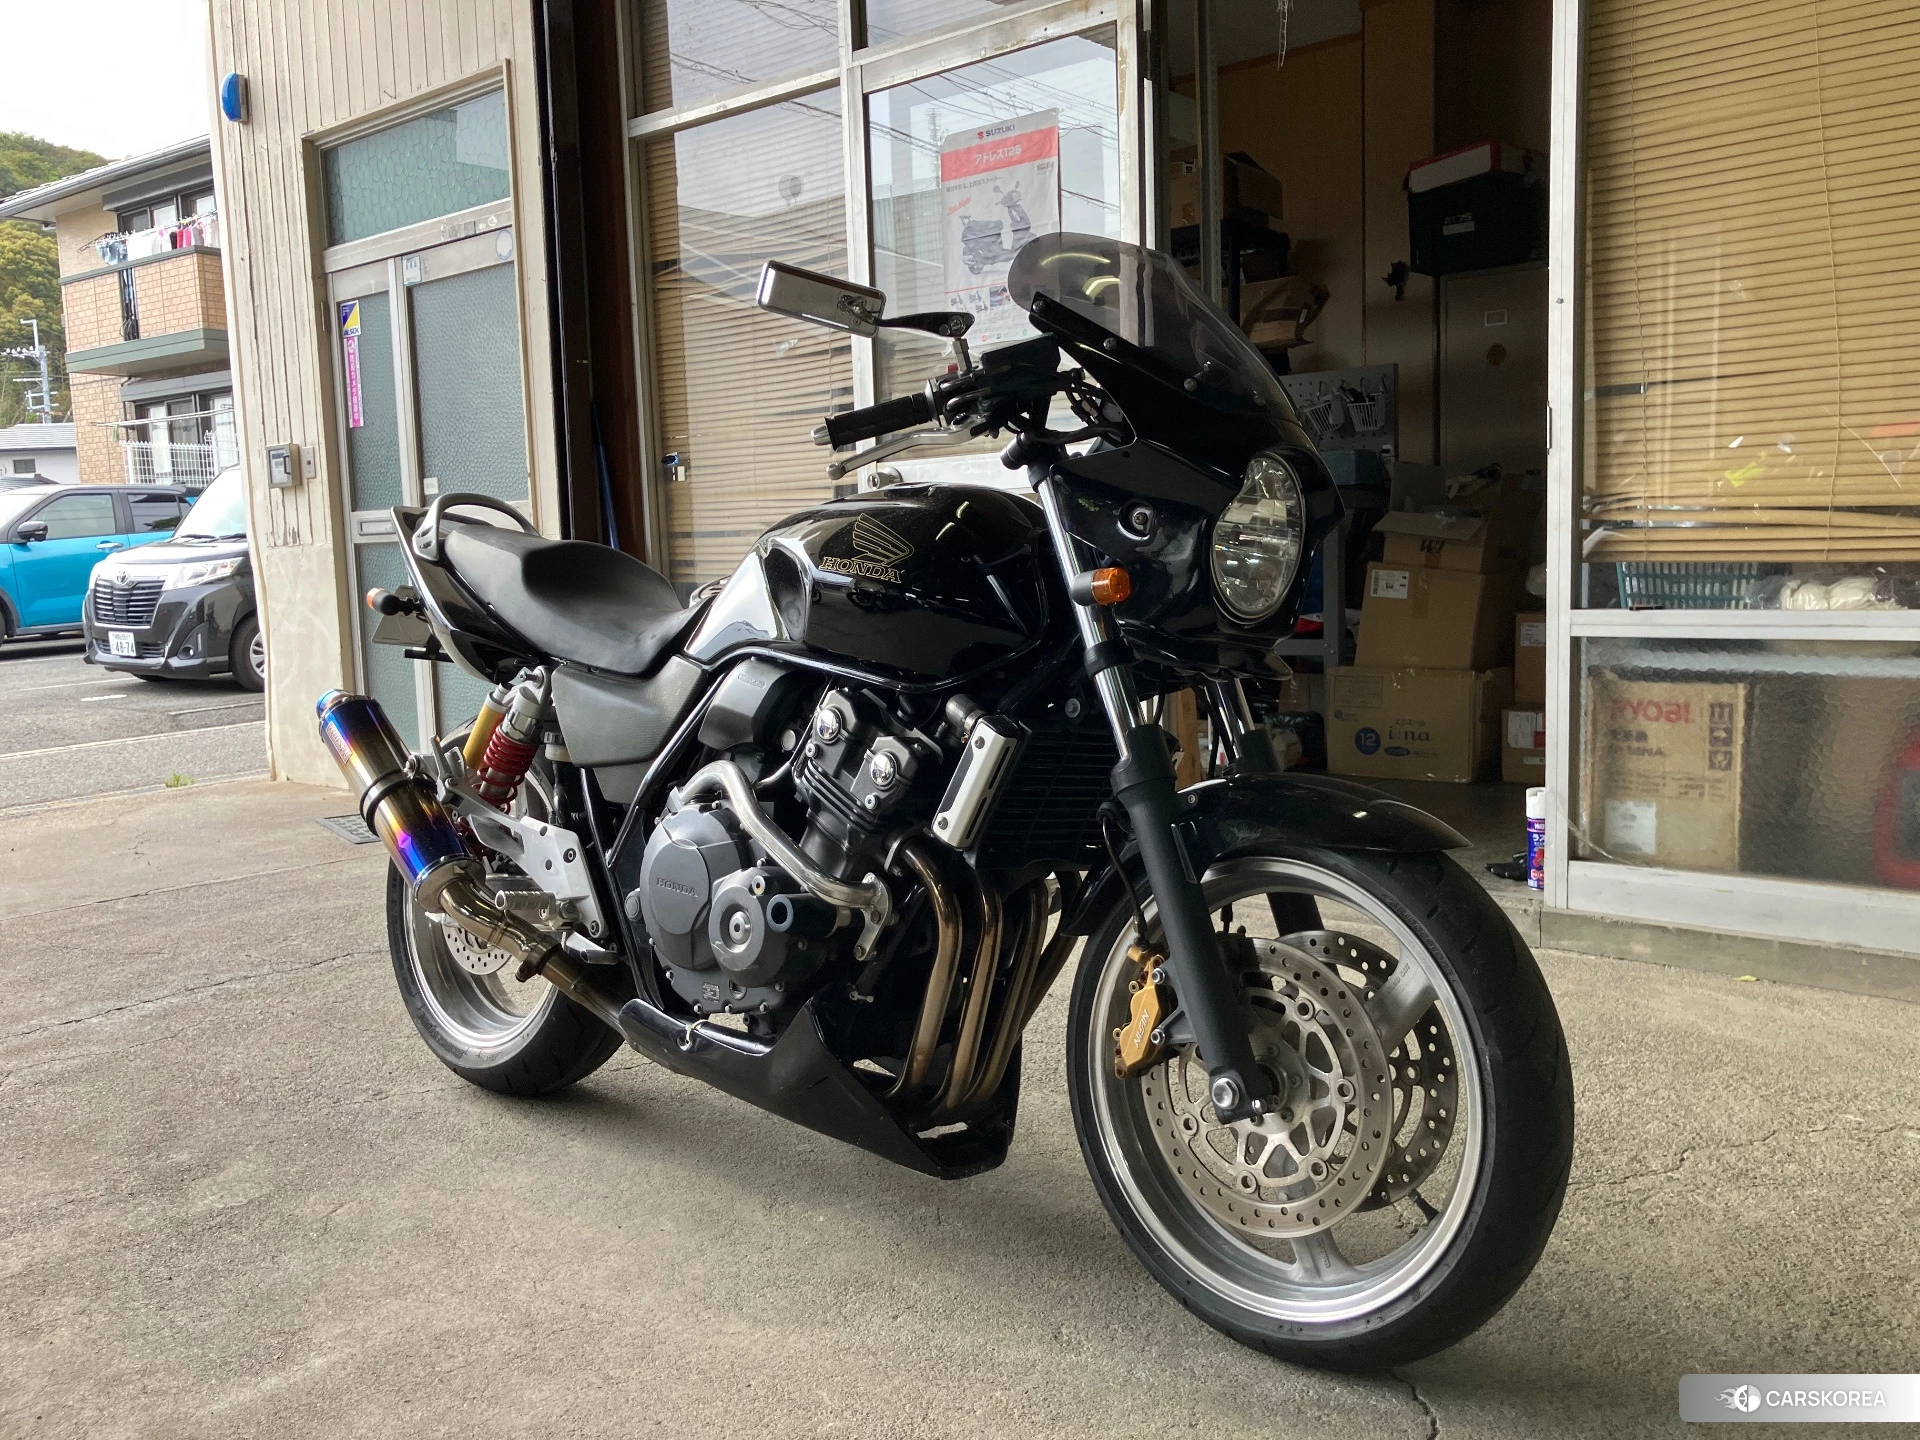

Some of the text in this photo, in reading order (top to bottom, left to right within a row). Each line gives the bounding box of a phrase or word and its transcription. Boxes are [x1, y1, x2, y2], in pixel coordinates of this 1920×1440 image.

[985, 124, 1015, 137] SUZUKI
[974, 145, 1021, 165] アドレス125
[818, 556, 902, 584] HONDA
[1360, 732, 1376, 747] 12
[656, 877, 699, 898] HONDA
[1133, 1009, 1149, 1049] NISSIN
